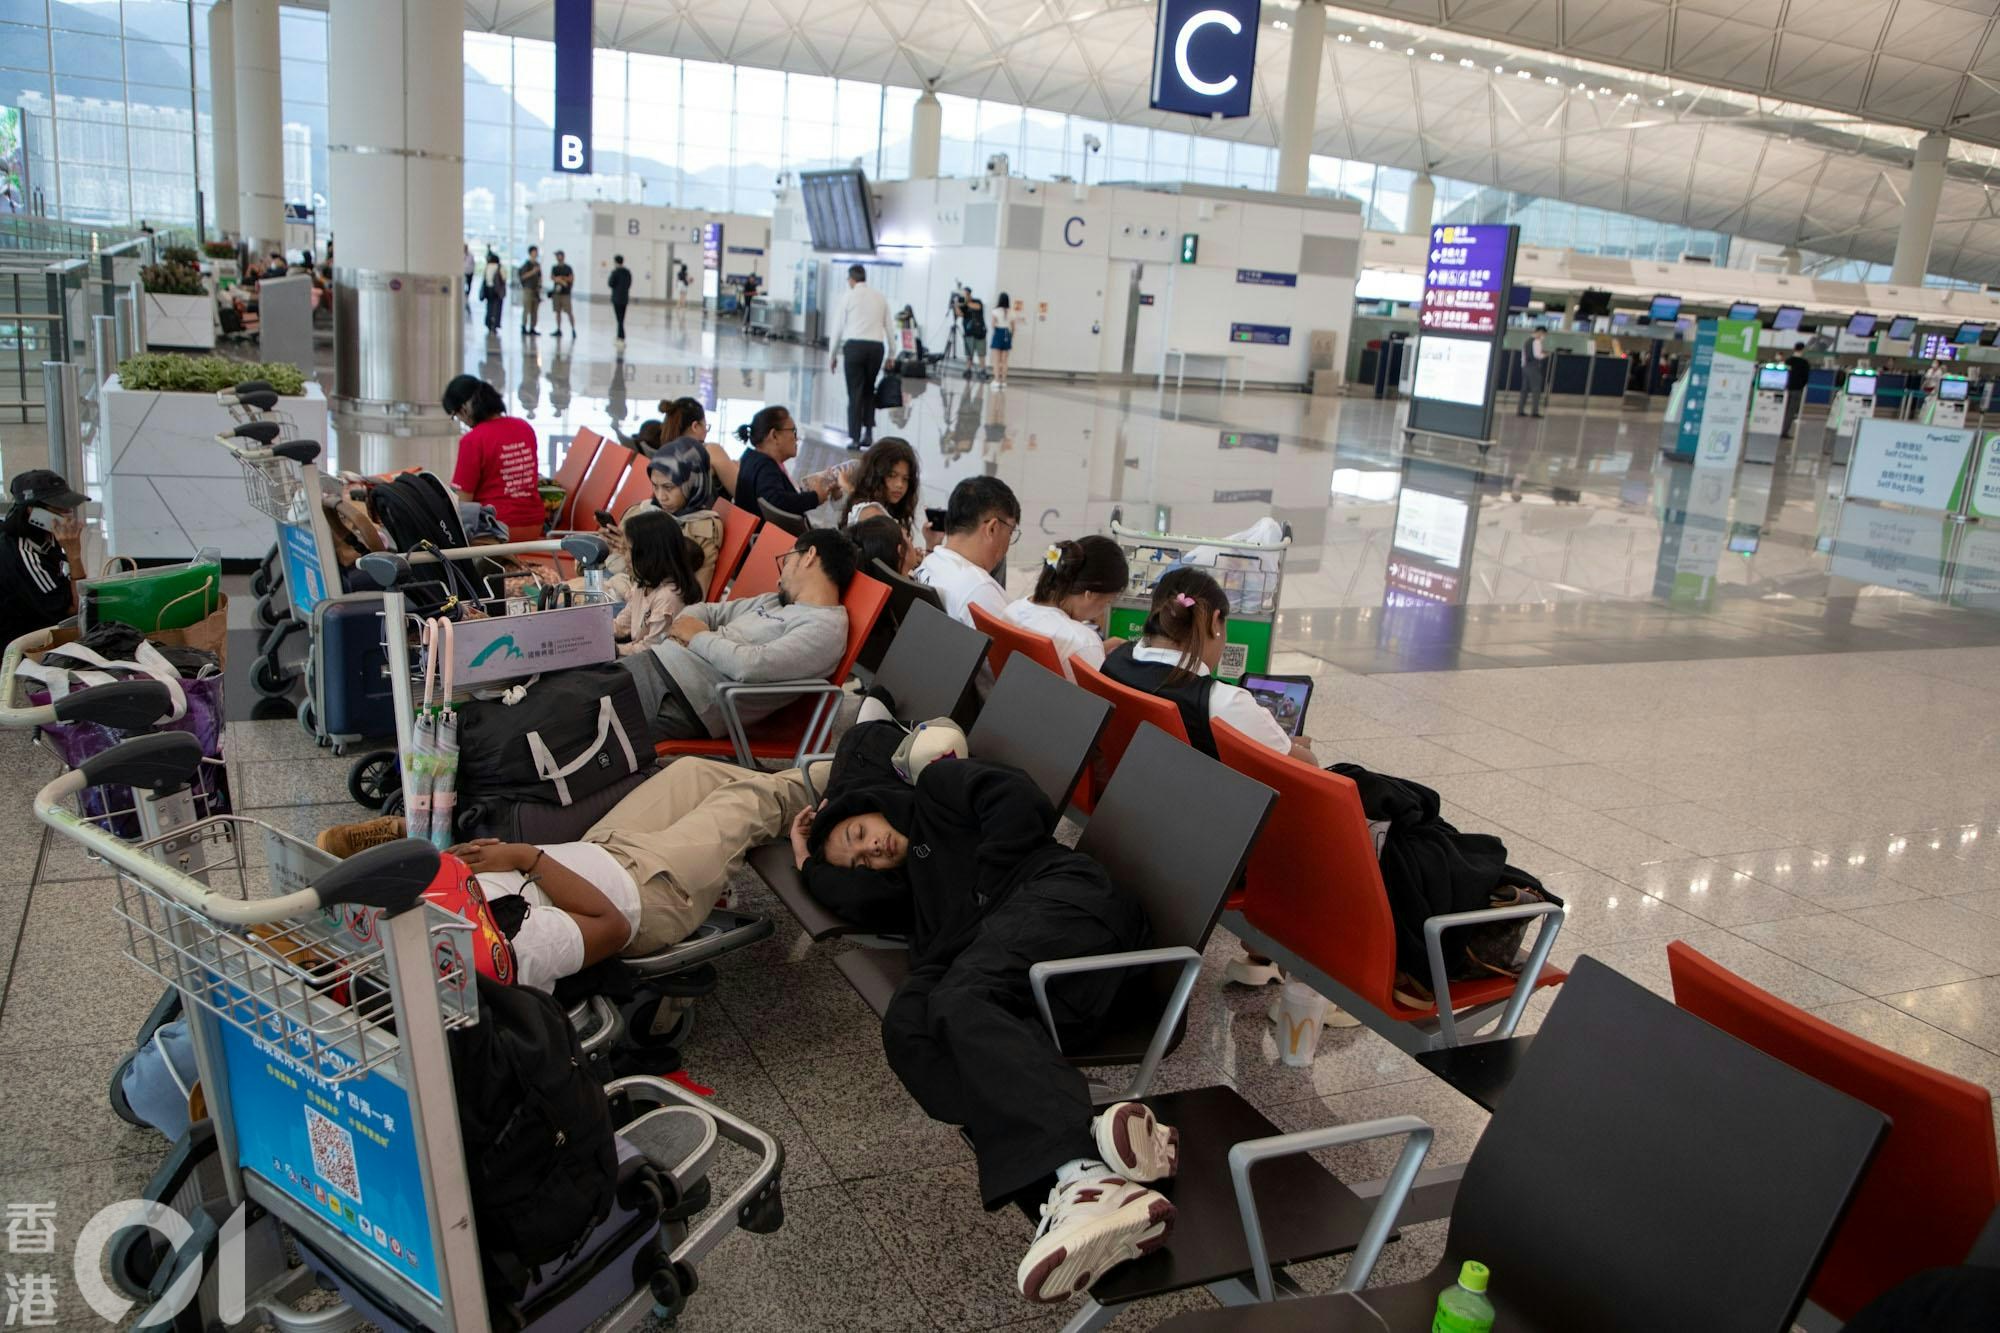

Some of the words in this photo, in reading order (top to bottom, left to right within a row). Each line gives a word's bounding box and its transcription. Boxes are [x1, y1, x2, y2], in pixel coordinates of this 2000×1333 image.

[1175, 10, 1242, 95] C
[562, 134, 584, 169] B
[628, 218, 640, 235] B
[1063, 216, 1086, 248] C
[1740, 326, 1754, 353] 1
[1884, 449, 1898, 457] Self
[1891, 480, 1906, 493] Bag
[1906, 483, 1925, 496] Drop
[347, 1090, 396, 1133] 四海一家
